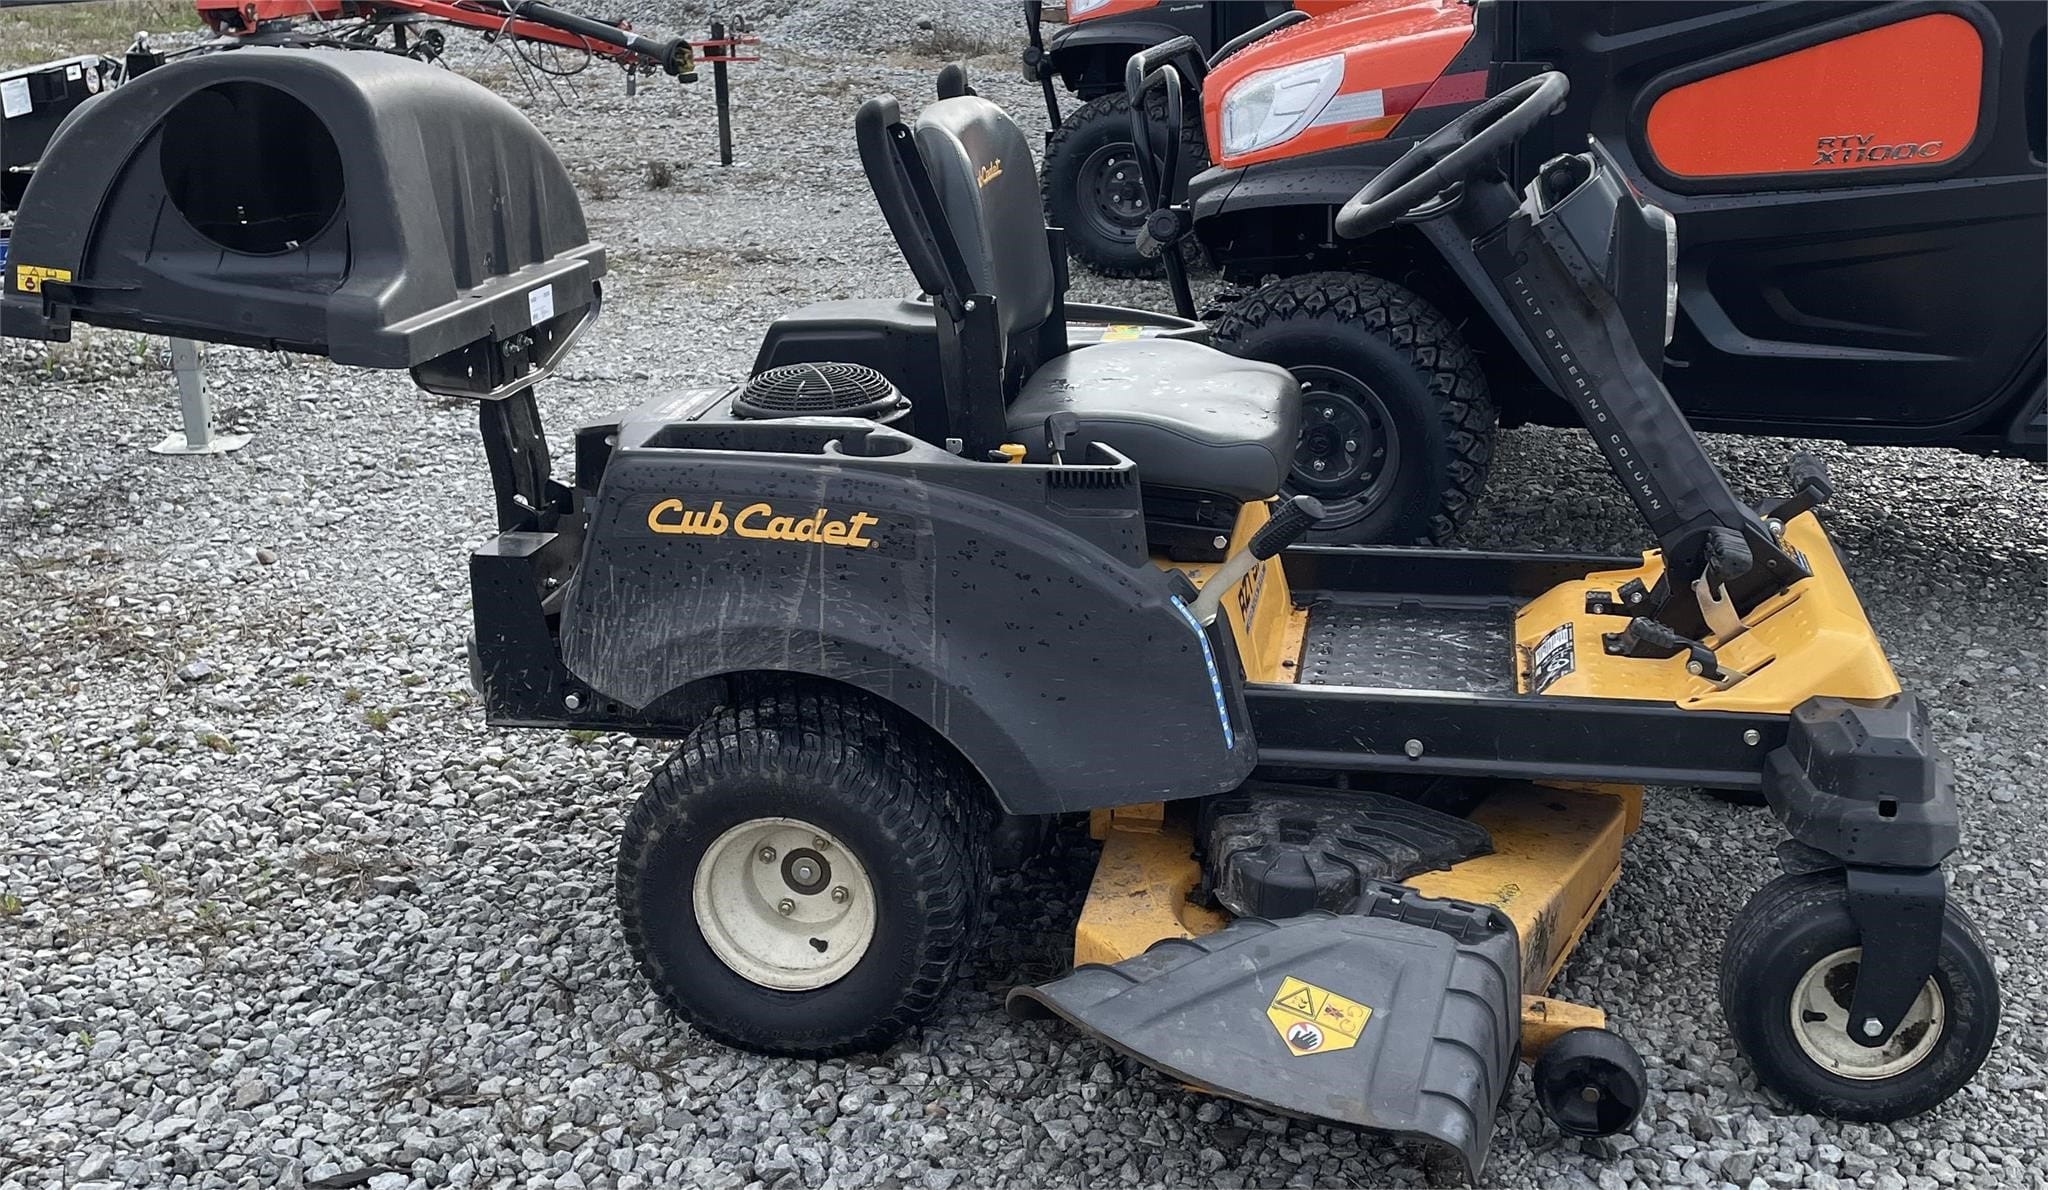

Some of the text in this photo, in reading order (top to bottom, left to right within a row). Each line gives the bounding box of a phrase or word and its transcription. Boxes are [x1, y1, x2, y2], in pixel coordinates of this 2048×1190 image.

[1817, 133, 1875, 148] RTV
[1515, 277, 1662, 510] TILT STEERING COLUMN
[647, 498, 730, 536] Cub
